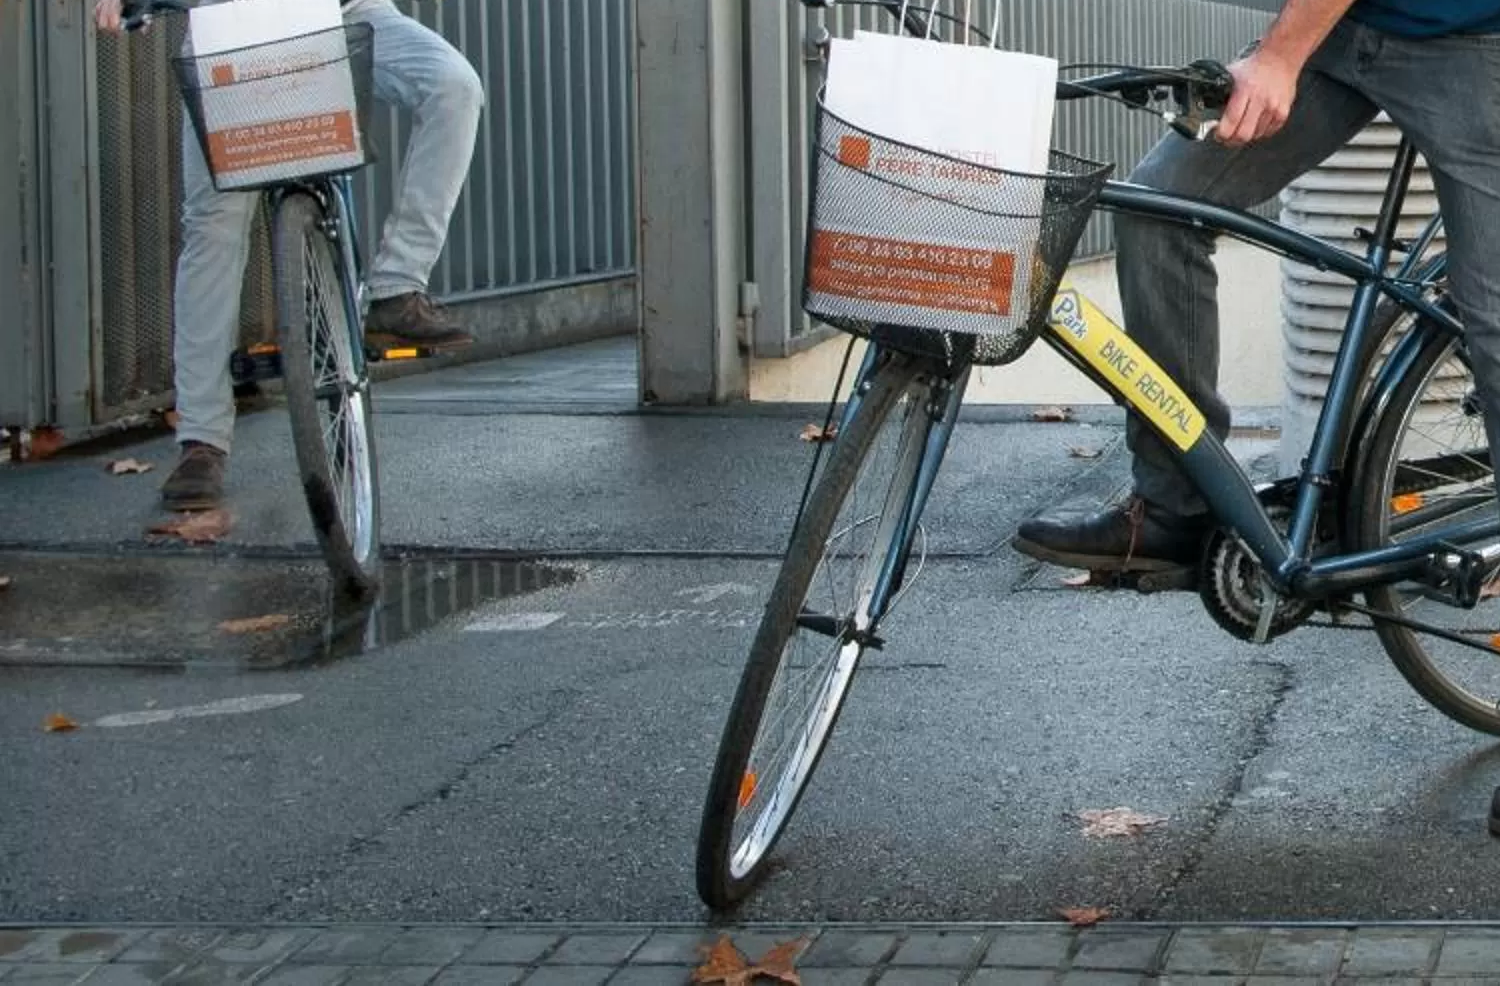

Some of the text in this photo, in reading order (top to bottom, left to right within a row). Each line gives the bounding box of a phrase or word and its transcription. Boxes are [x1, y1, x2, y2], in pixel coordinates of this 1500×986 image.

[1054, 296, 1088, 339] Park
[1099, 340, 1193, 435] BIKE RENTAL
